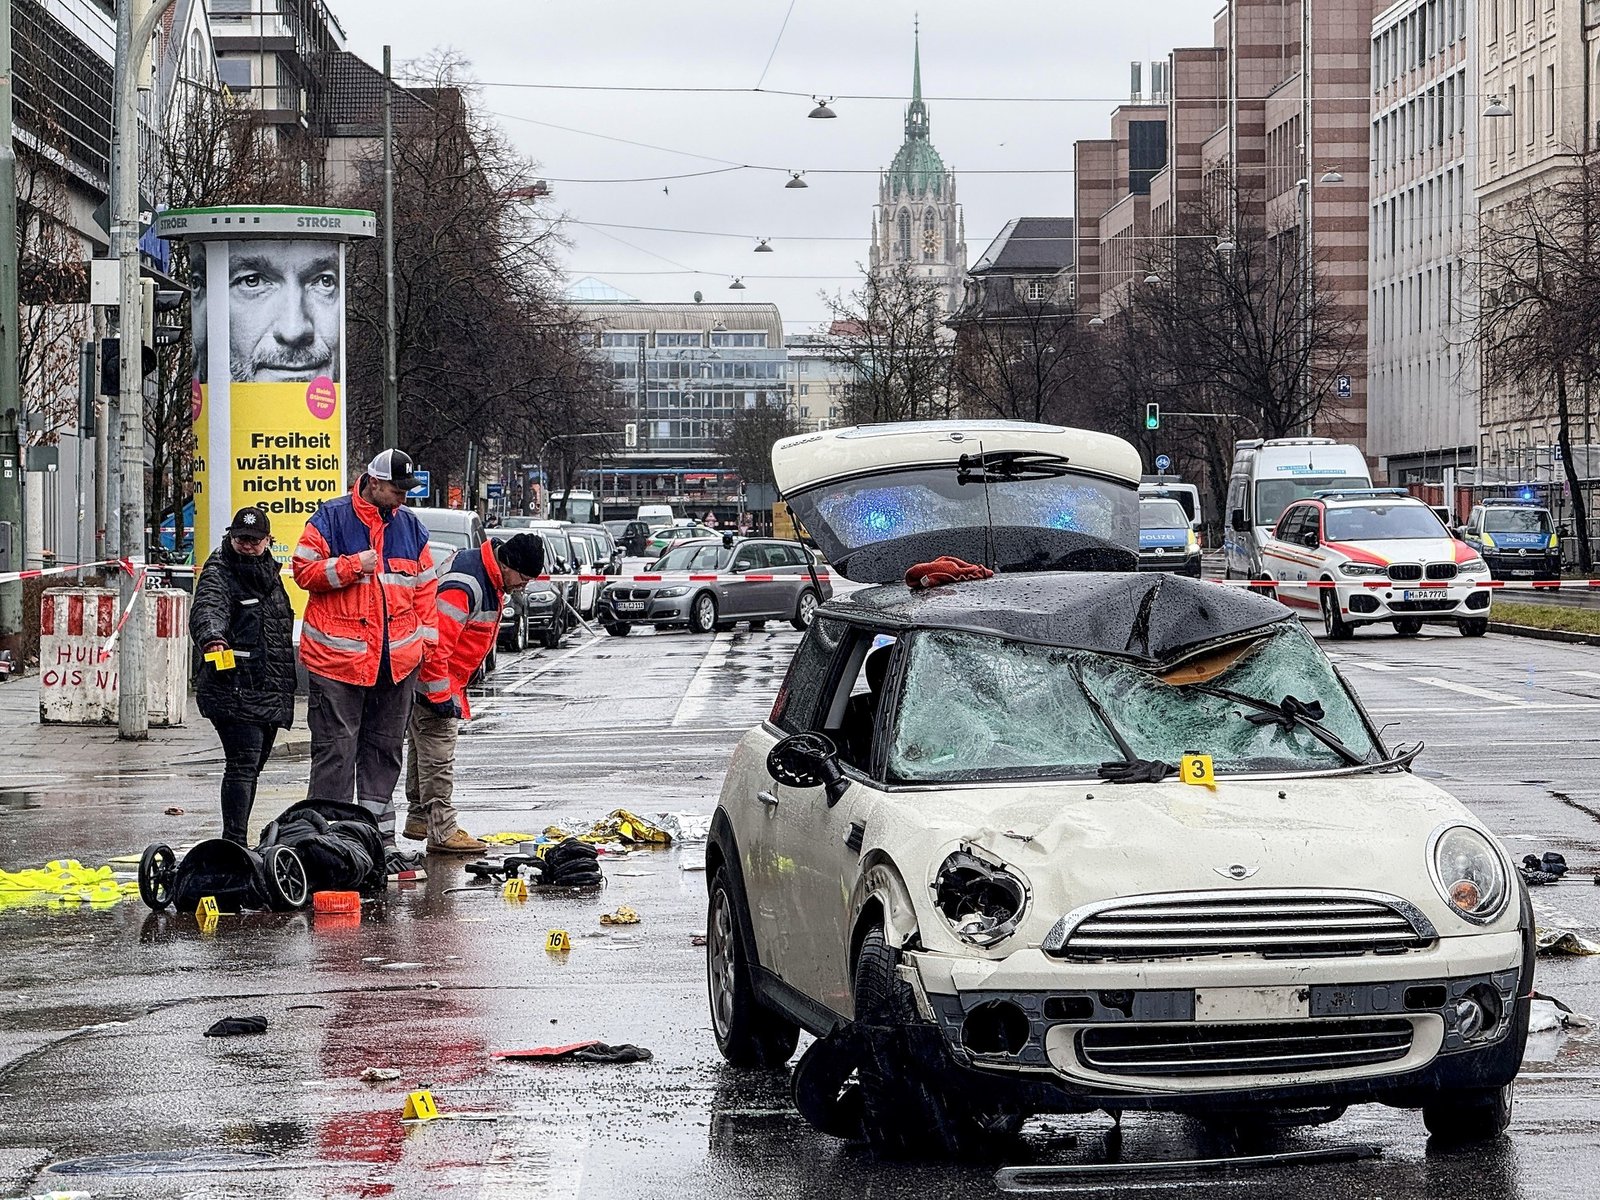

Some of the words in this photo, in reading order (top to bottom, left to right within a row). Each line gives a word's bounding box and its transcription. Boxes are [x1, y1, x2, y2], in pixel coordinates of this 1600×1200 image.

[160, 217, 187, 229] STRÖER
[297, 216, 341, 228] STRÖER
[1340, 379, 1347, 390] P
[251, 432, 331, 449] Freiheit
[236, 453, 301, 470] wählt
[305, 454, 339, 470] sich
[243, 476, 301, 492] nicht
[305, 479, 336, 492] von
[1191, 759, 1206, 779] 3
[509, 881, 519, 894] 11
[205, 899, 217, 912] 14
[549, 932, 562, 947] 16
[419, 1095, 430, 1113] 1
